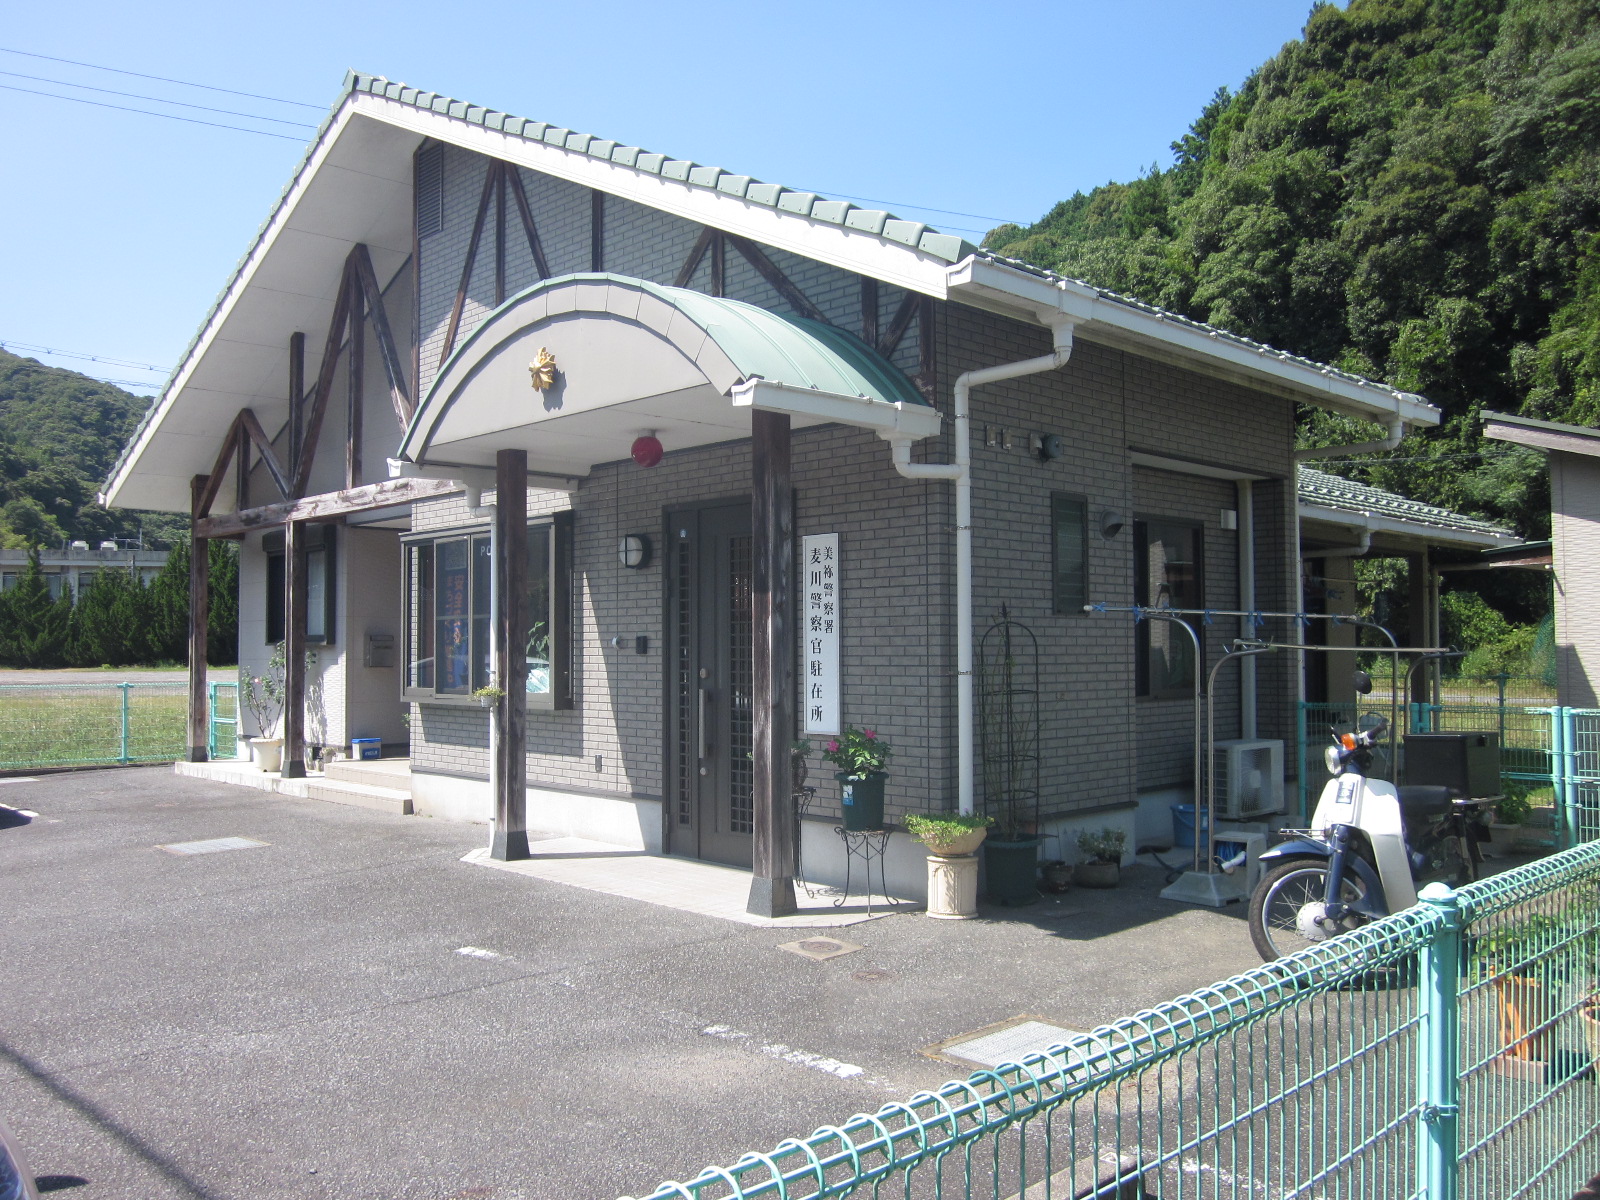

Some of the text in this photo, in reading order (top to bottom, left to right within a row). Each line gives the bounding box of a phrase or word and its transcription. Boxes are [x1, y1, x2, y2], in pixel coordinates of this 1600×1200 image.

[810, 548, 823, 722] 麦川警察官駐在所
